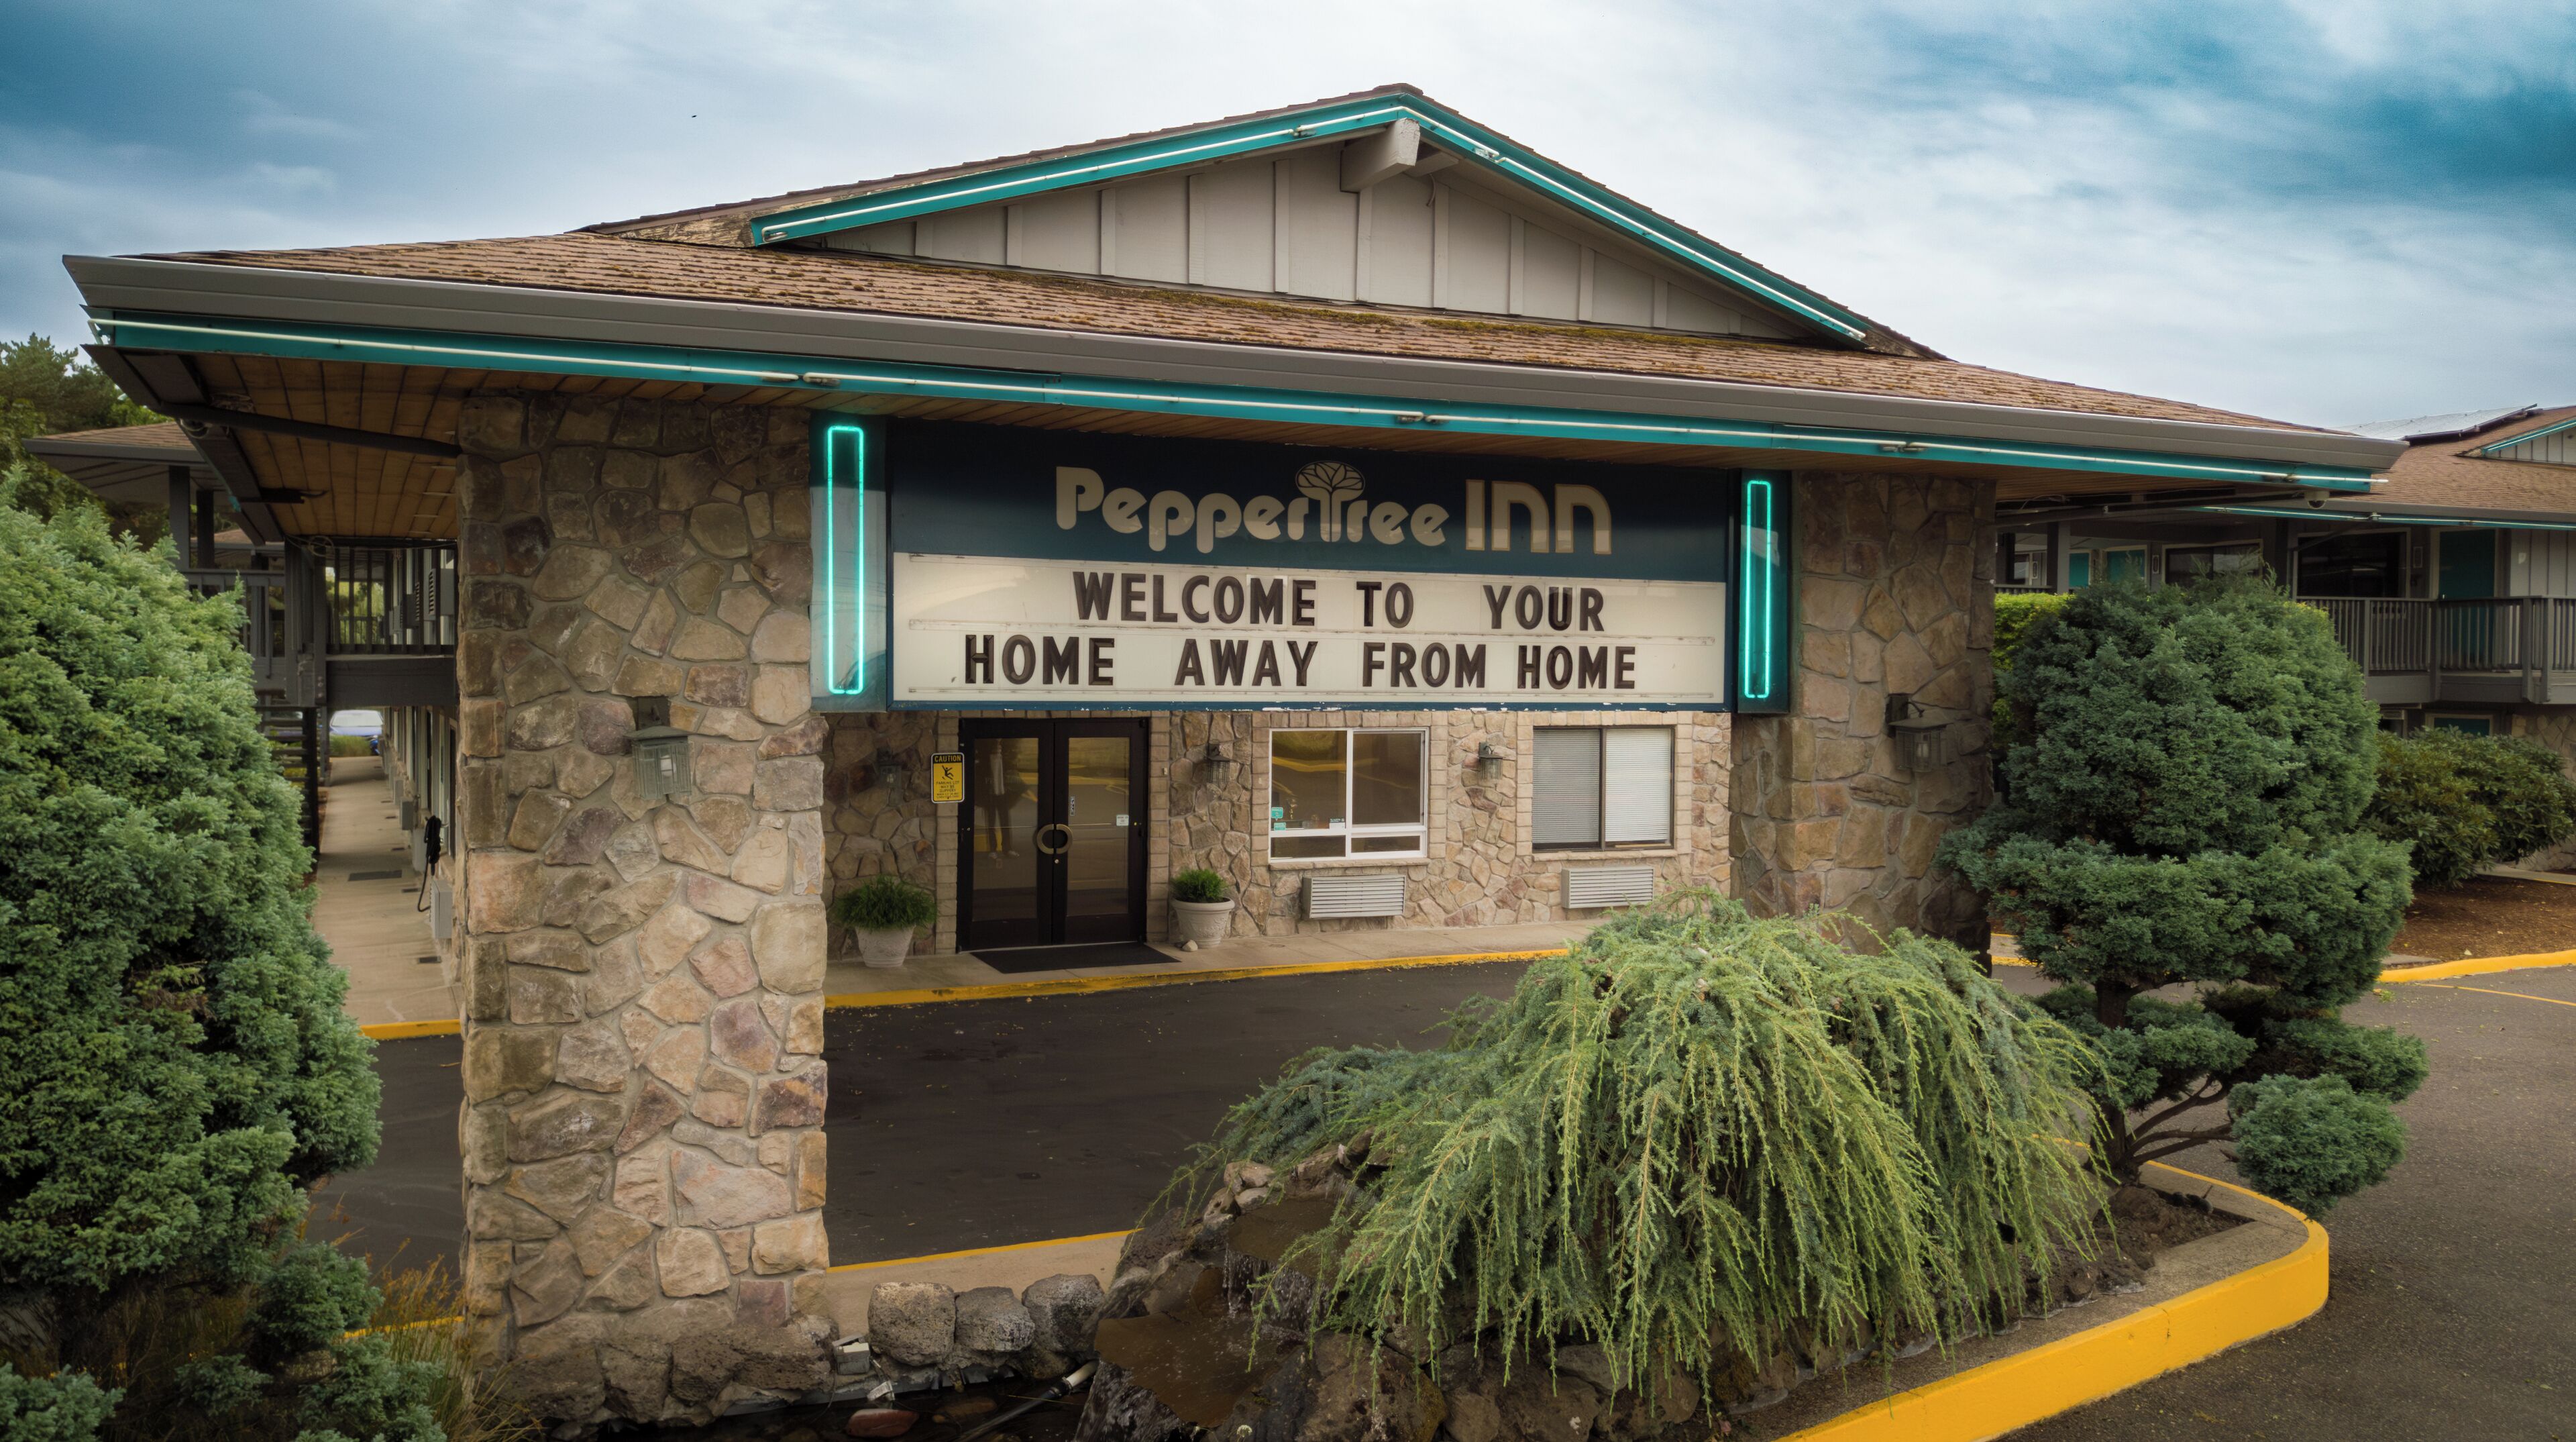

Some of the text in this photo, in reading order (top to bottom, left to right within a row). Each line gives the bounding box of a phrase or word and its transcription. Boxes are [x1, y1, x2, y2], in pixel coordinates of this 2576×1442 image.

[1073, 571, 1605, 632] WELCOME TO YOUR
[965, 634, 1636, 690] HOME AWAY FROM HOME
